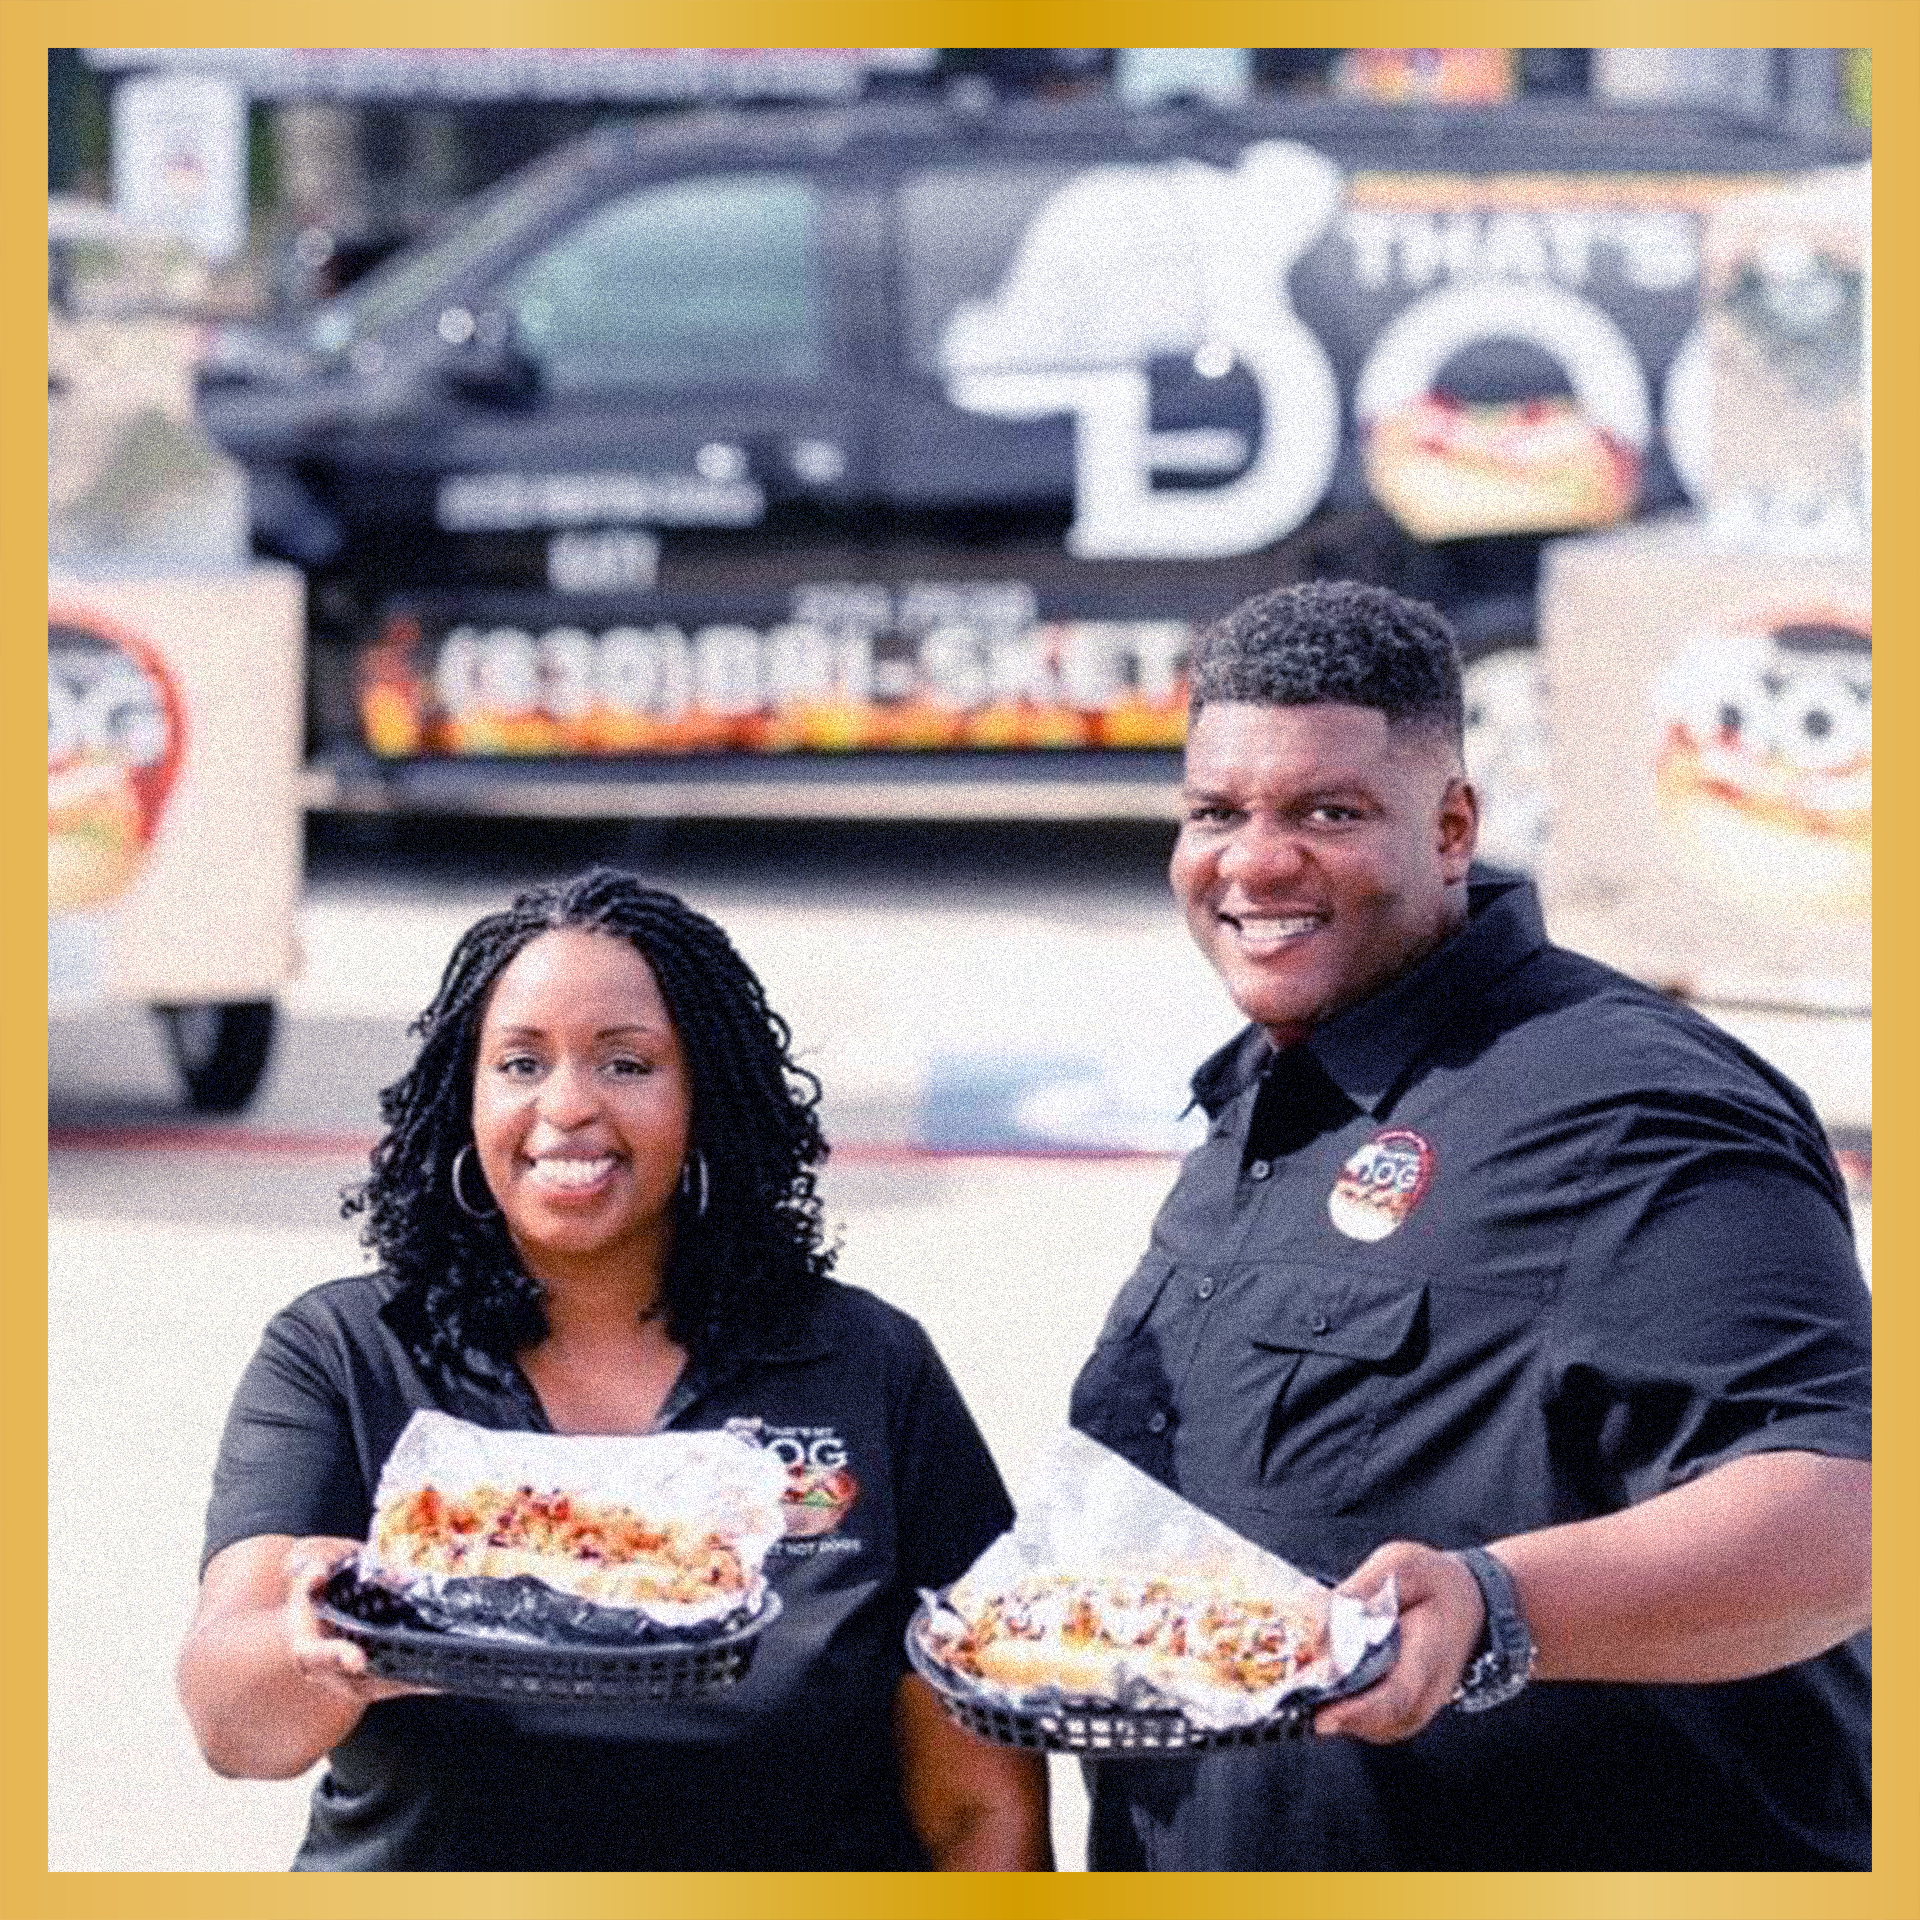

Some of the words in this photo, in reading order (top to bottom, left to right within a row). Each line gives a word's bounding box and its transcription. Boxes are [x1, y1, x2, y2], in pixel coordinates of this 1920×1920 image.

[1347, 209, 1696, 292] THAT'S
[978, 172, 1712, 560] DO
[763, 1437, 849, 1470] OG
